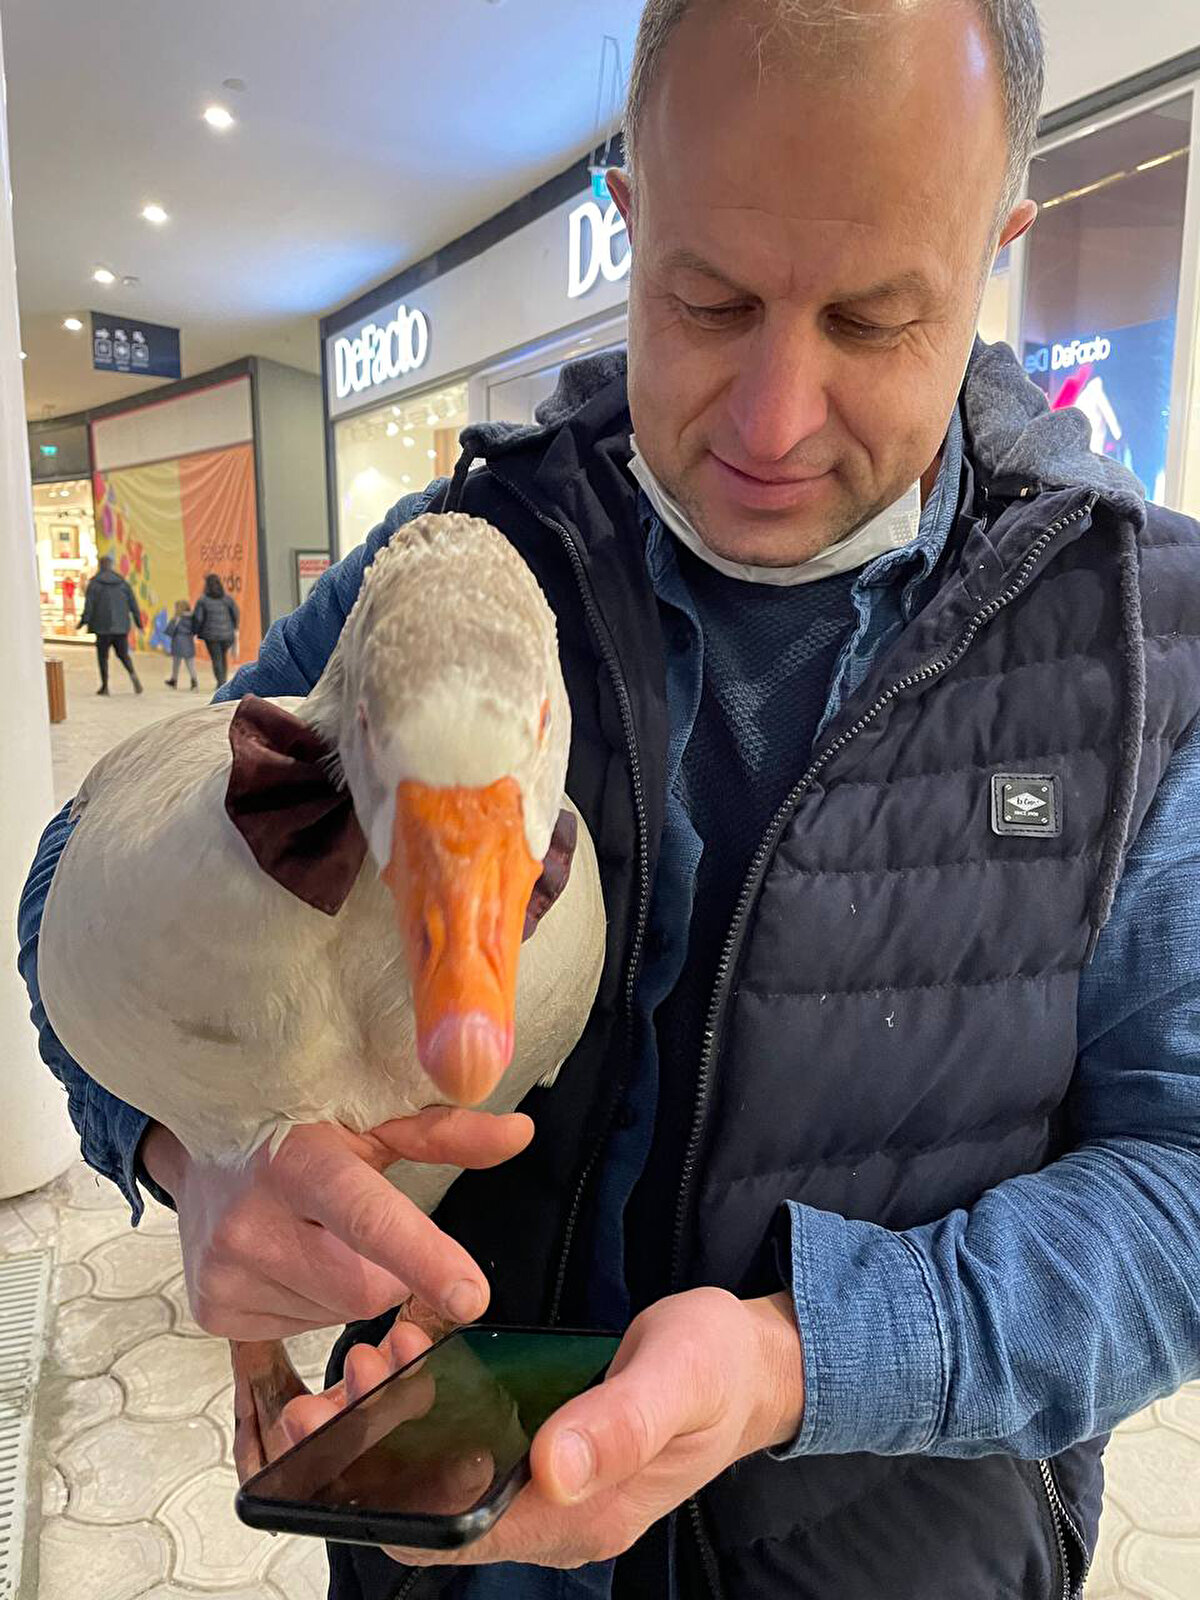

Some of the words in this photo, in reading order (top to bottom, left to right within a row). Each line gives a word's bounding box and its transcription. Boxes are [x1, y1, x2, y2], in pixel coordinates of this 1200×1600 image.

[567, 201, 632, 299] De
[334, 304, 428, 398] DeFacto
[1051, 336, 1110, 370] DeFacto
